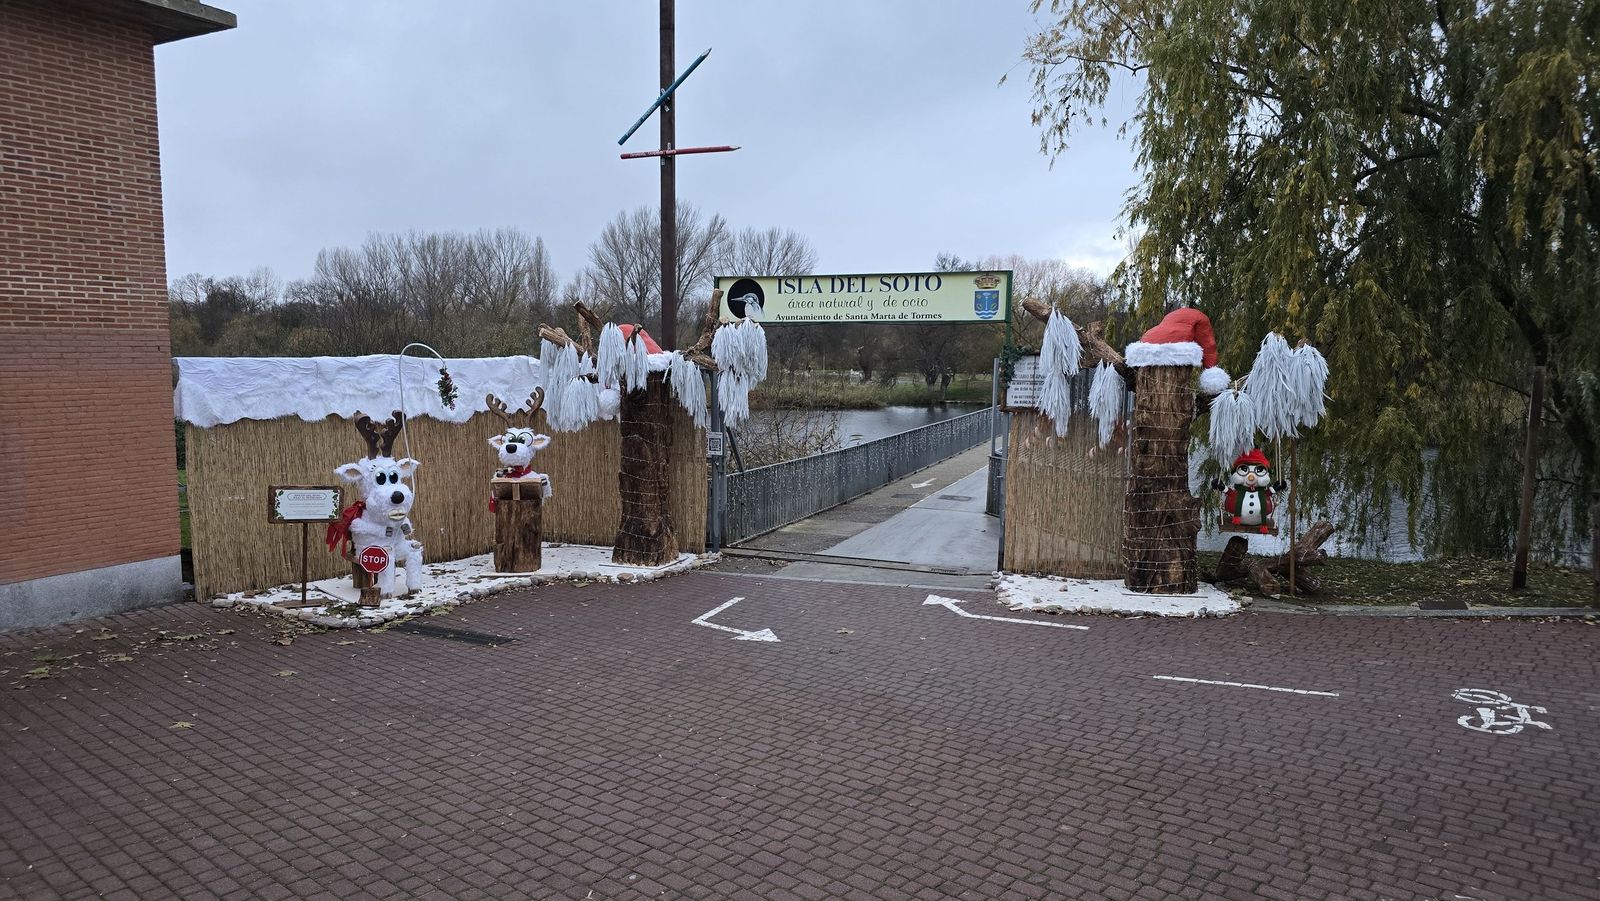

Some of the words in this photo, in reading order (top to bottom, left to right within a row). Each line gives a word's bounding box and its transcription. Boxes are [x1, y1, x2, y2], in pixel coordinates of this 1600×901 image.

[777, 278, 823, 294] ISLA
[830, 277, 873, 293] DEL
[879, 275, 942, 292] SOTO
[788, 298, 814, 309] área
[818, 296, 863, 309] natural
[867, 300, 874, 311] y
[883, 295, 897, 308] de
[902, 297, 929, 308] ocio
[834, 313, 843, 321] de
[899, 312, 909, 320] de
[910, 312, 942, 320] Tormes
[362, 555, 386, 564] STOP
